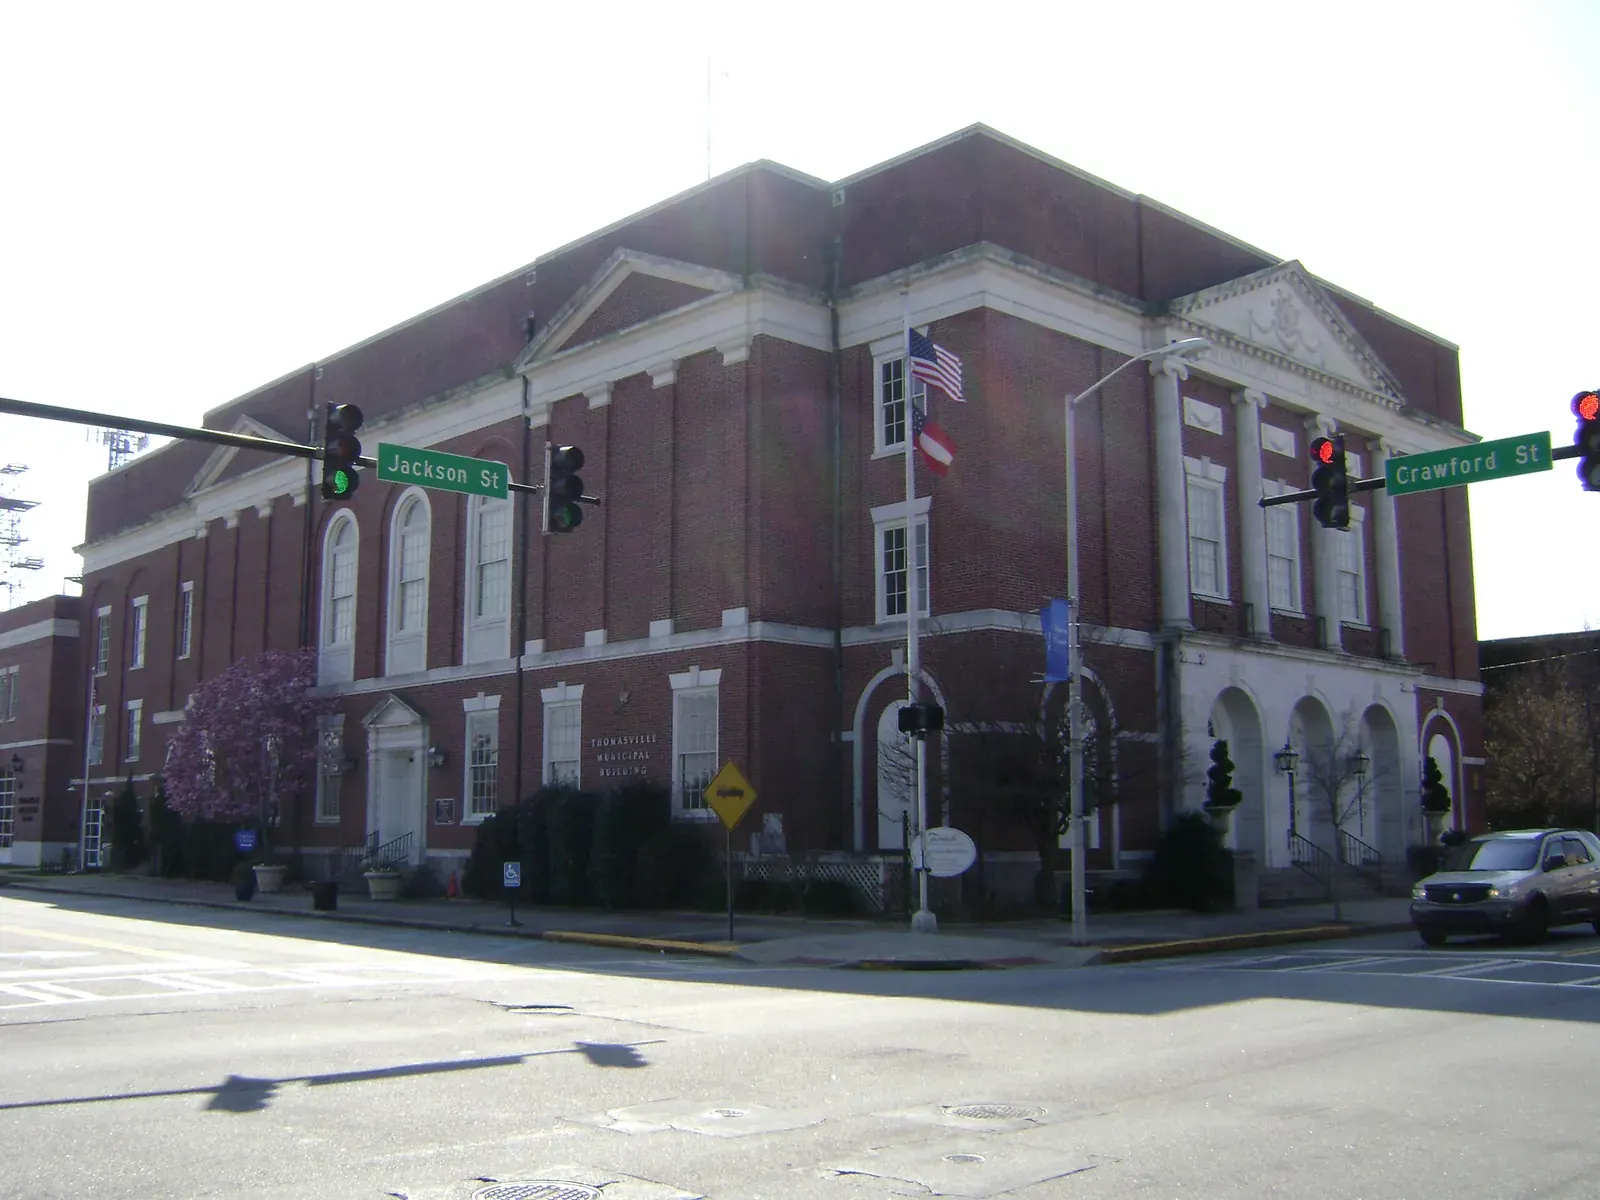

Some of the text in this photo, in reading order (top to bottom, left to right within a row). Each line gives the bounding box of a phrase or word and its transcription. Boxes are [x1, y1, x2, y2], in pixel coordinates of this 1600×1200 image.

[1396, 444, 1539, 484] Crawford St
[388, 454, 499, 489] Jackson St
[591, 734, 657, 747] THOMASVILLE
[596, 751, 650, 761] MUNICIPAL
[600, 766, 647, 777] BUILDING
